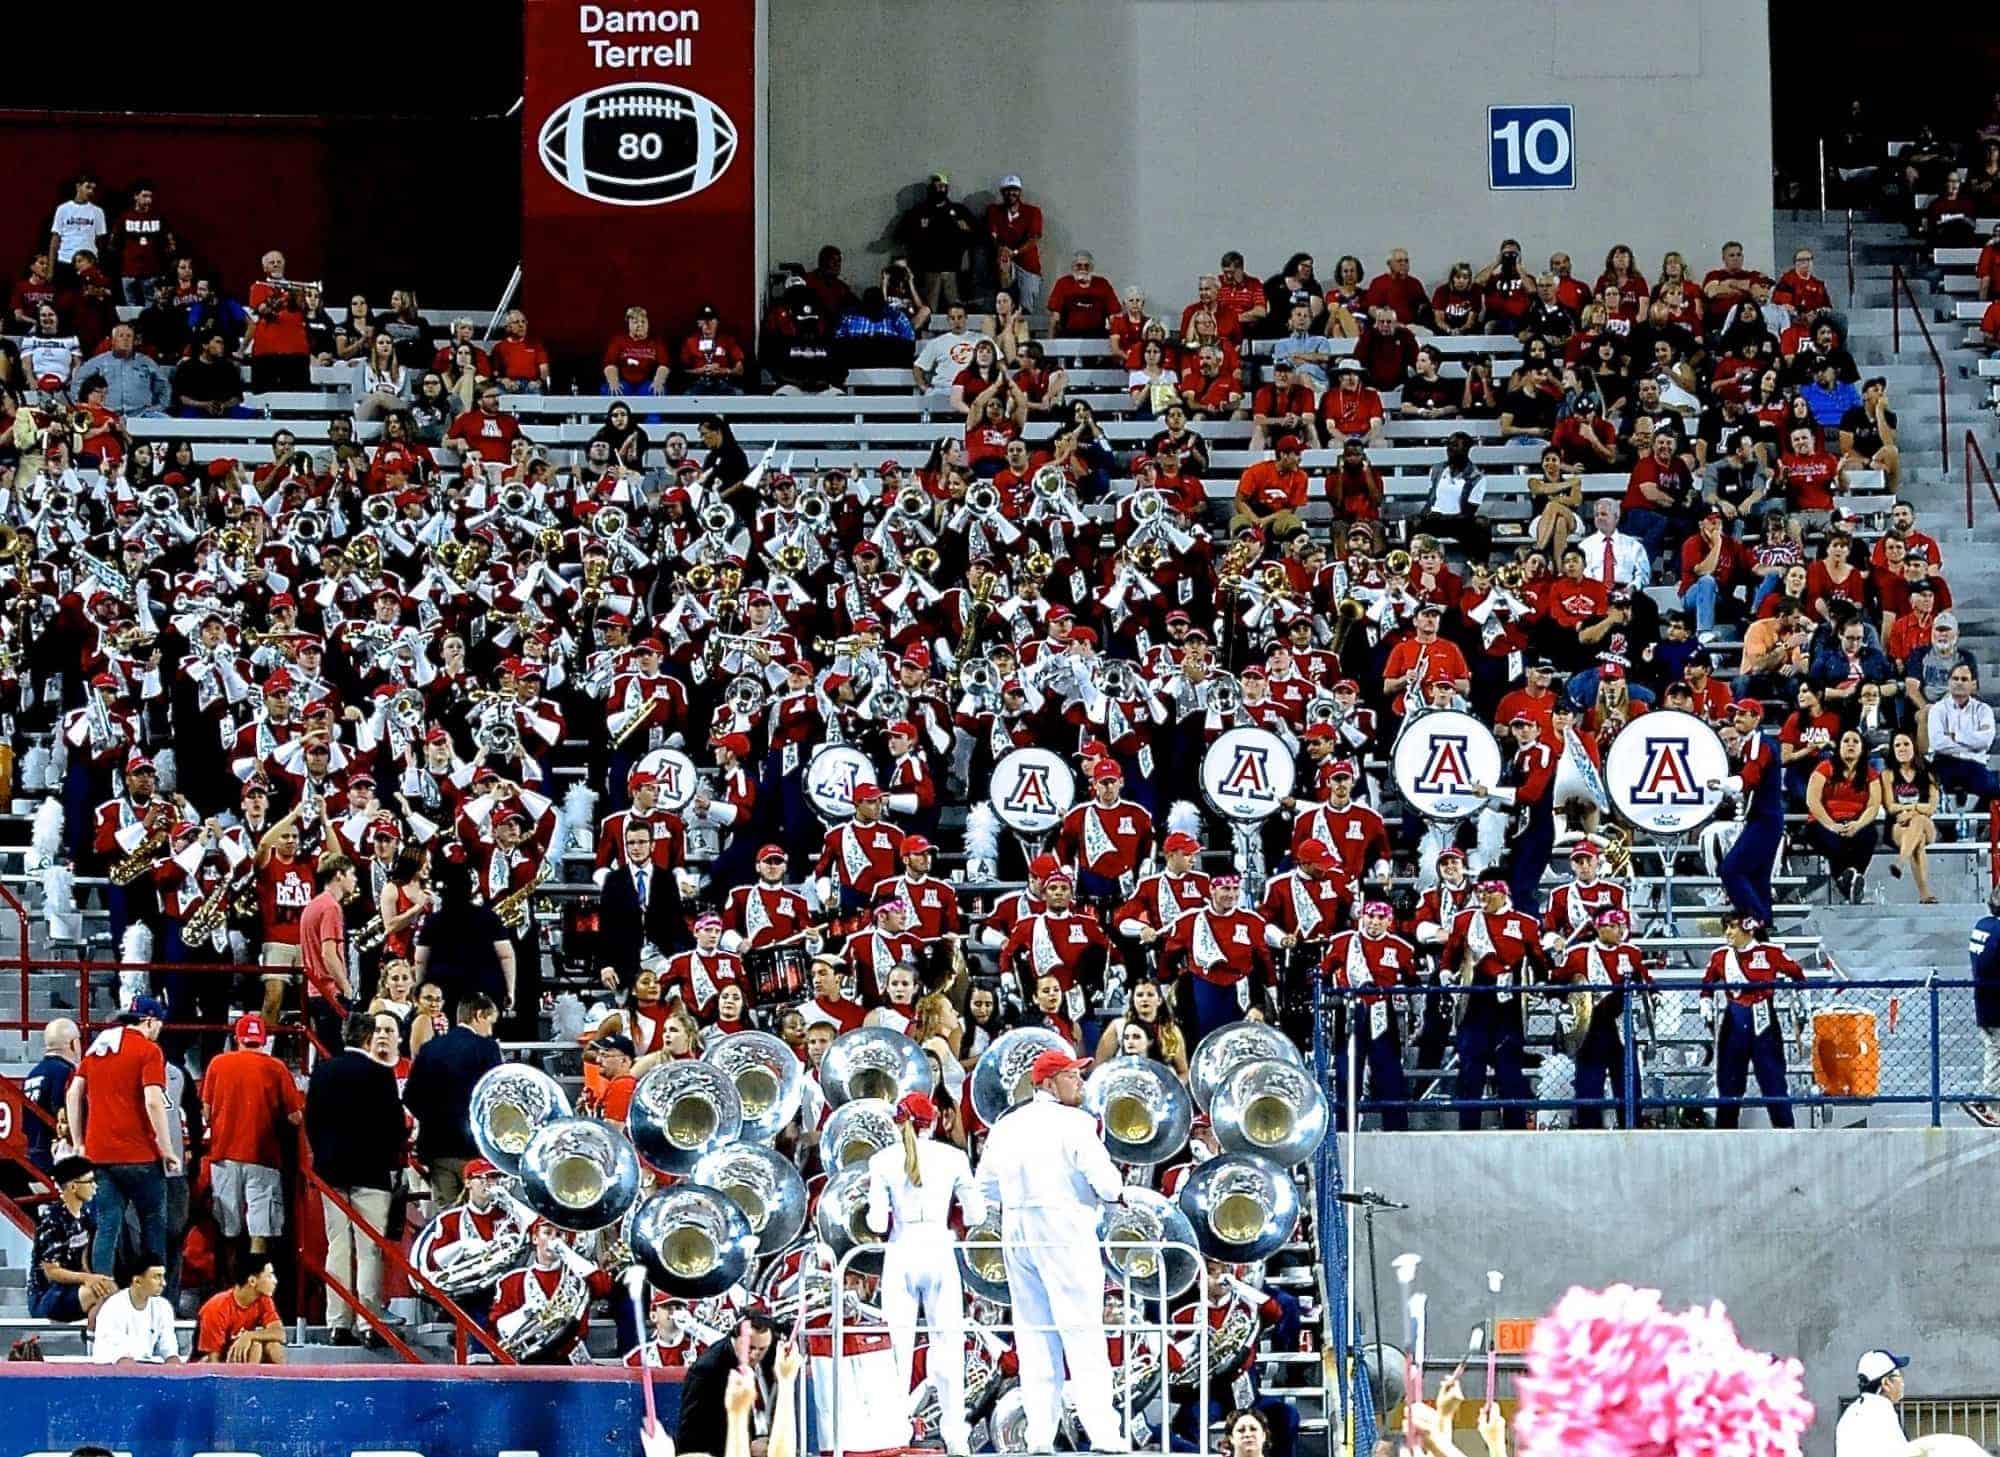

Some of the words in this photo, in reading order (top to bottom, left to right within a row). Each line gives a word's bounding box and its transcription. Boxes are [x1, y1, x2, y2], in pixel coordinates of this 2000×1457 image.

[579, 5, 699, 33] Damon
[587, 38, 692, 68] Terrell
[618, 133, 662, 160] 80
[1493, 118, 1570, 175] 10
[816, 761, 859, 801] A
[1218, 745, 1275, 801] A
[1414, 734, 1475, 795] A
[1630, 737, 1704, 804] A
[1004, 764, 1056, 815] A
[1500, 1323, 1529, 1350] EXI
